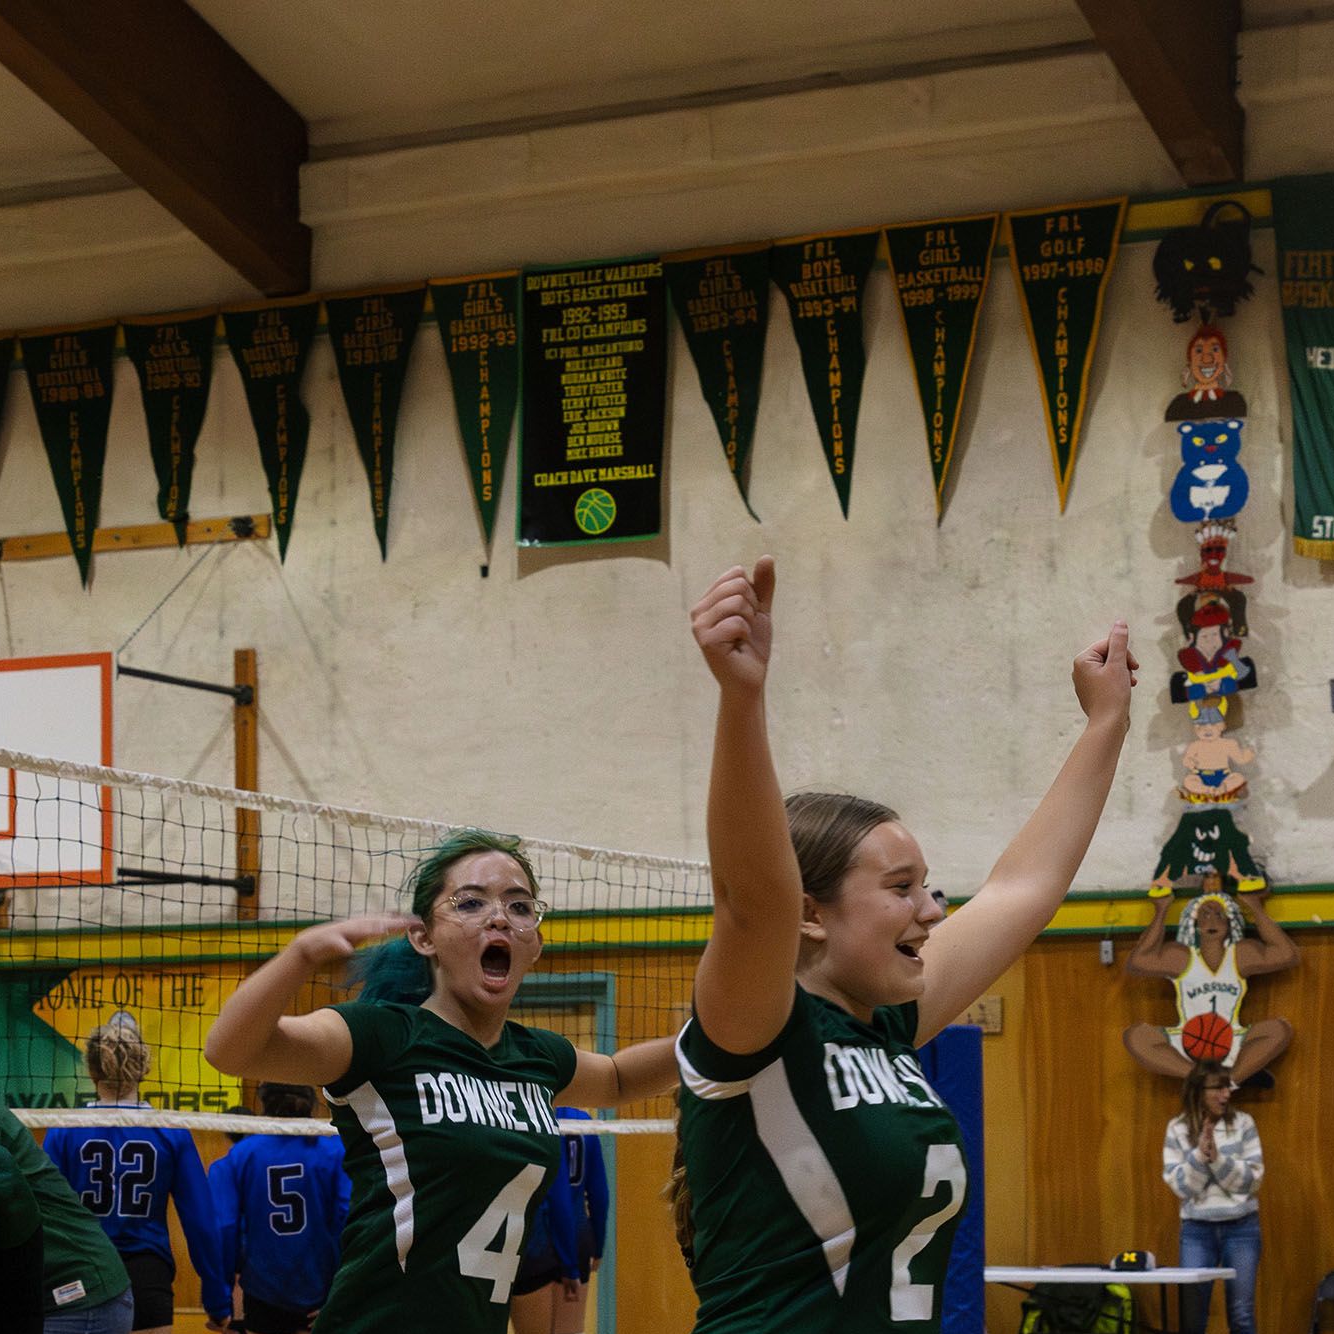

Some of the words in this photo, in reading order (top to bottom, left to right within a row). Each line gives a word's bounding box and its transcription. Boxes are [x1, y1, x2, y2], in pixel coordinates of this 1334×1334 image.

[1046, 215, 1081, 233] FRL
[925, 228, 957, 246] FRL
[1040, 237, 1085, 257] GOLF
[803, 241, 836, 259] FRL
[918, 246, 961, 266] GIRLS
[526, 269, 603, 291] DOWNIEVILLE
[605, 262, 663, 281] WARRIORS
[801, 258, 842, 278] BOYS
[899, 266, 983, 288] BASKETBALL
[1022, 257, 1104, 282] 1997-1998
[467, 281, 497, 299] FRL
[572, 281, 648, 302] BASKETBALL
[463, 298, 505, 316] GIRLS
[562, 302, 627, 324] 1992-1993
[449, 312, 516, 336] BASKETBALL
[582, 318, 647, 339] CHAMPIONS
[450, 330, 517, 353] 1992-93
[1055, 287, 1068, 445] CHAMPIONS
[826, 318, 845, 474] CHAMPIONS
[934, 310, 946, 462] CHAMPIONS
[478, 351, 493, 502] CHAMPIONS
[534, 471, 568, 486] COACH
[599, 464, 656, 482] MARSHALL
[112, 973, 143, 1009] OF
[154, 973, 205, 1007] THE
[79, 1138, 157, 1217] 32
[267, 1163, 306, 1236] 5
[457, 1163, 547, 1304] 4
[889, 1144, 966, 1321] 2
